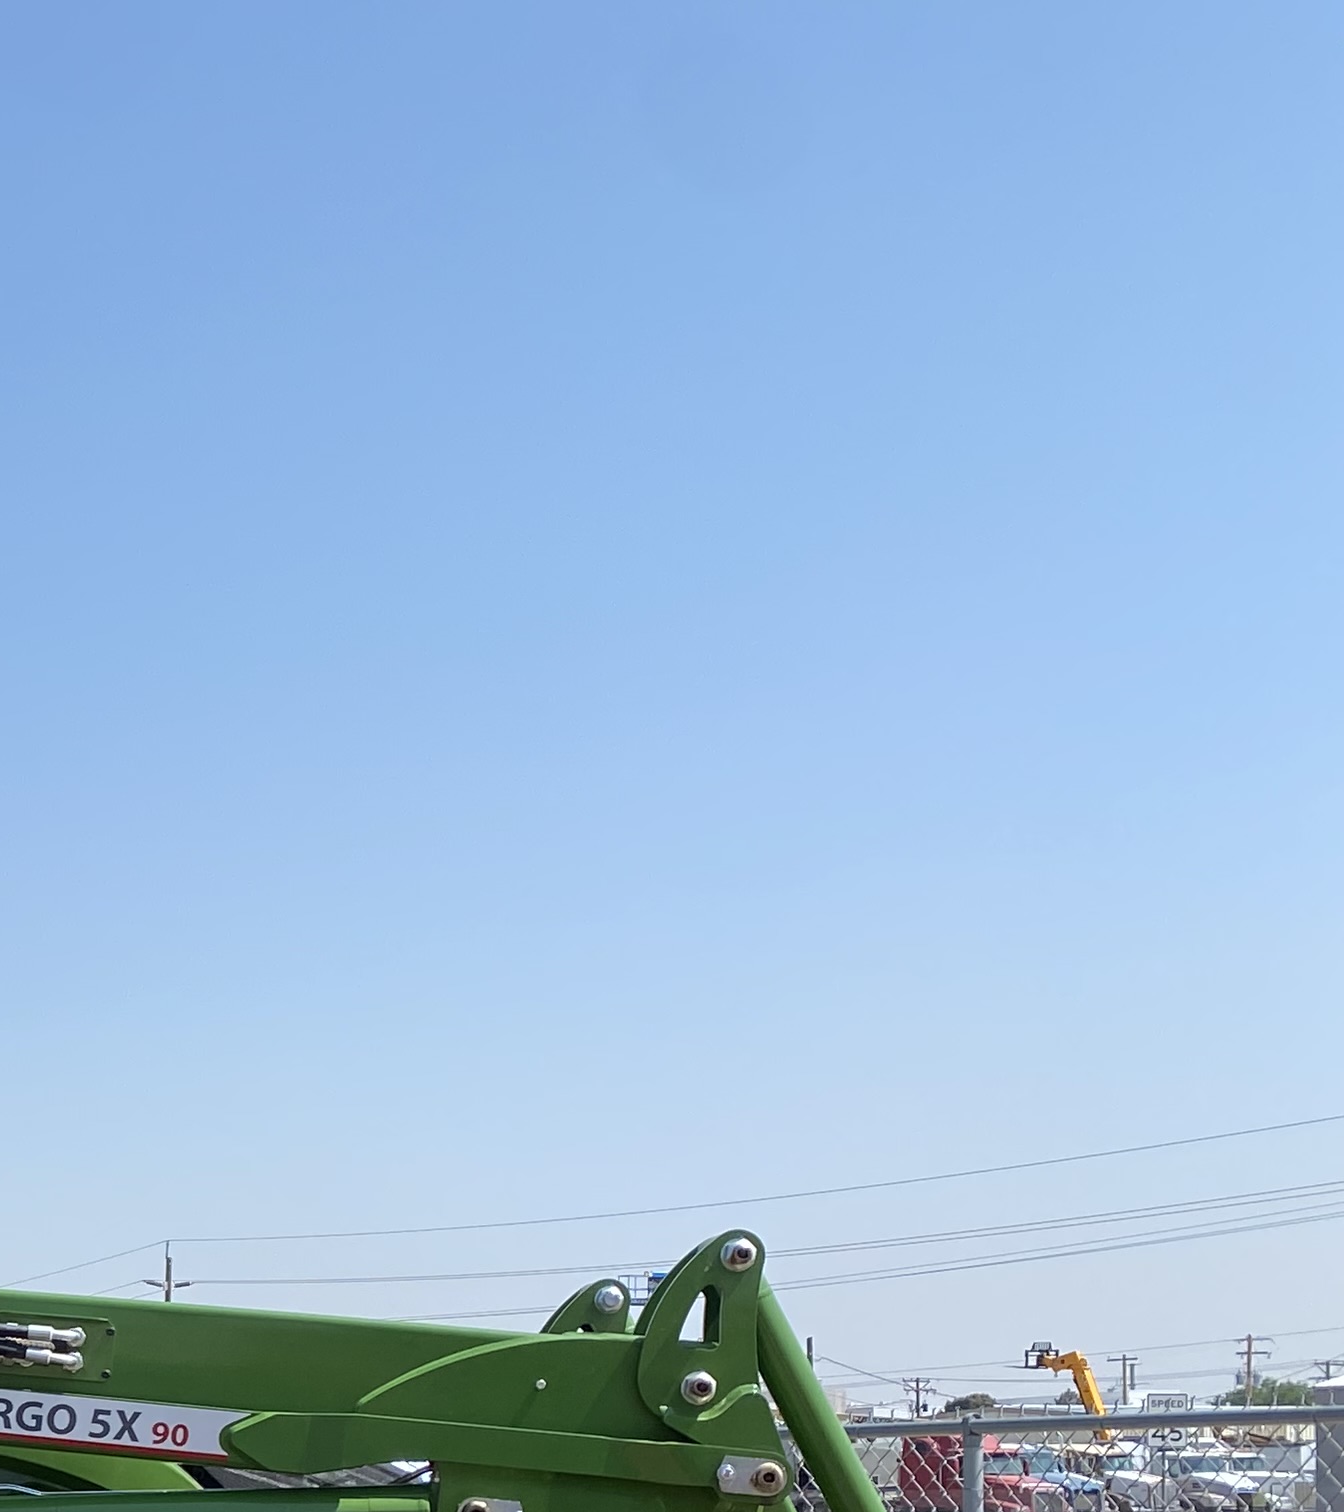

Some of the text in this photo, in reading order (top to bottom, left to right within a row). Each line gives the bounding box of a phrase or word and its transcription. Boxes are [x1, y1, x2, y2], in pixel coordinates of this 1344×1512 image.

[88, 1408, 142, 1443] 5X
[150, 1421, 190, 1447] 90
[1151, 1427, 1183, 1442] 45
